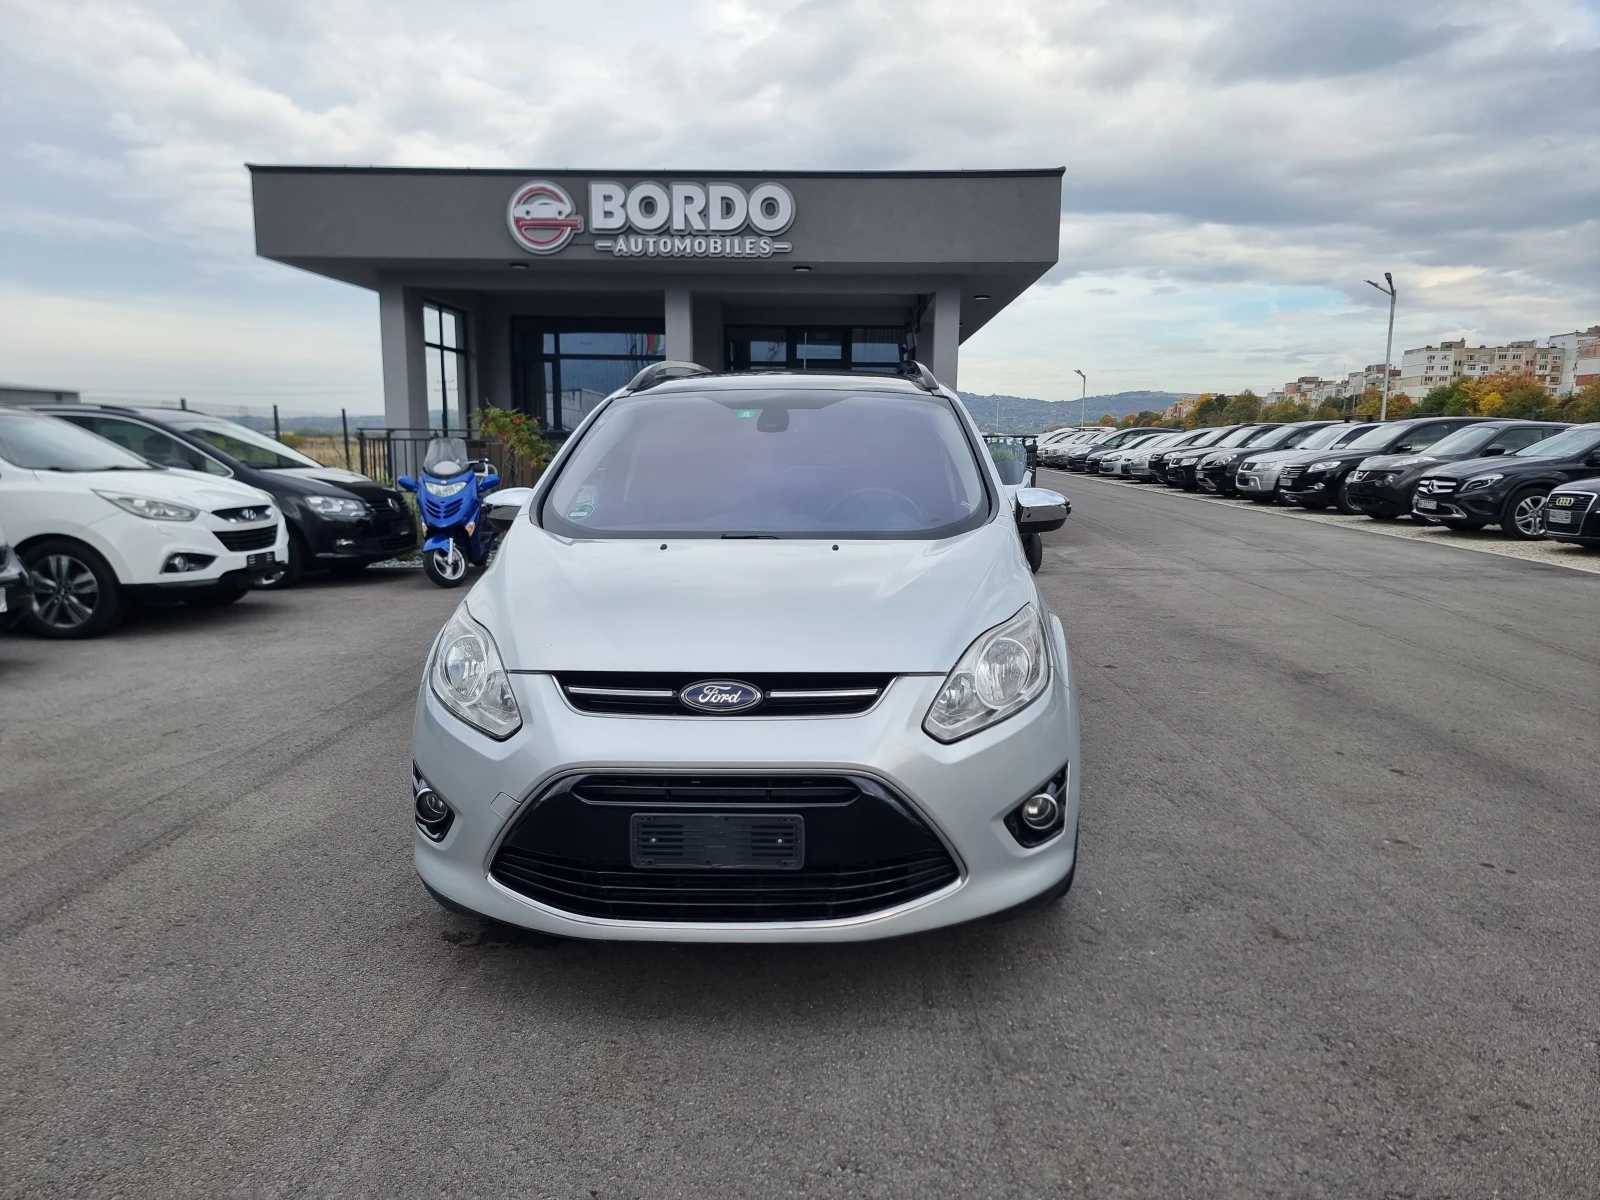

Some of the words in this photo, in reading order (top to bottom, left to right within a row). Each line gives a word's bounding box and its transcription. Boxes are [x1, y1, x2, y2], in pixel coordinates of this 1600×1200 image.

[590, 183, 793, 231] BORDO
[615, 237, 772, 254] AUTOMOBILES
[698, 685, 742, 703] Ford
